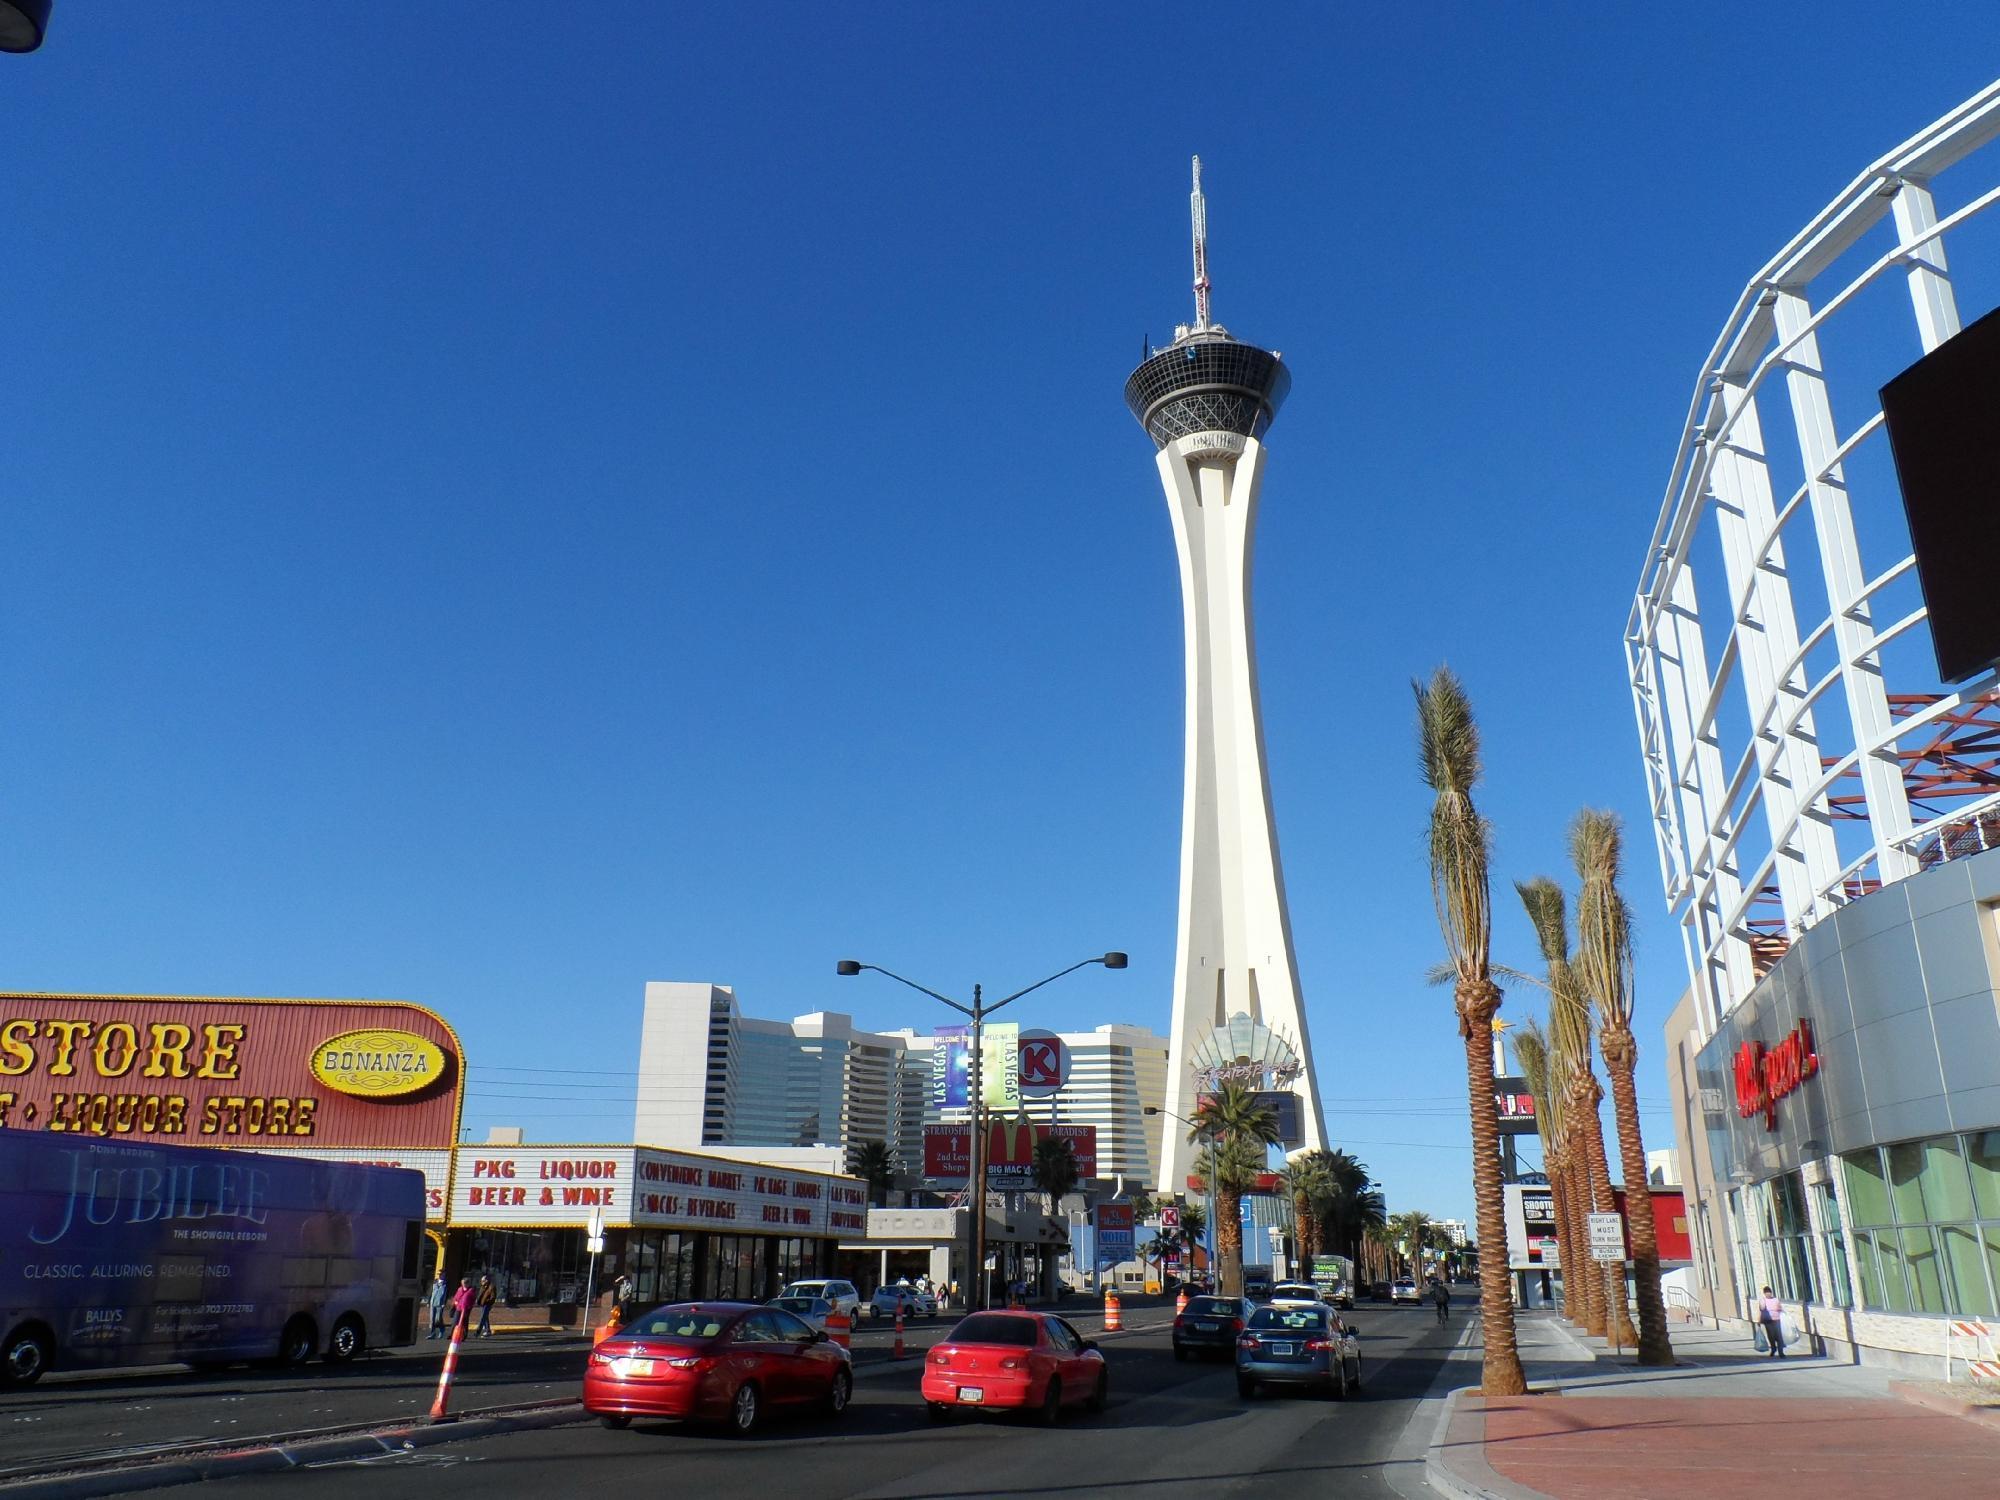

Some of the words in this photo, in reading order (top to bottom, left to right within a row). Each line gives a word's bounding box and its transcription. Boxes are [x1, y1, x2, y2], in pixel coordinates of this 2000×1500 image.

[0, 1018, 246, 1079] STORE
[1005, 1042, 1017, 1061] LAS
[324, 1050, 429, 1073] BONANZA
[933, 1045, 946, 1079] VEGAS
[1023, 1046, 1056, 1078] K
[933, 1083, 946, 1103] LAS
[1005, 1065, 1018, 1101] VEGAS
[47, 1092, 187, 1137] LIQUOR
[200, 1095, 318, 1136] STORE
[1049, 1127, 1089, 1136] PARADISE
[936, 1152, 951, 1161] 2nd
[473, 1160, 516, 1178] PKG
[540, 1160, 616, 1180] LIQUOR
[640, 1161, 703, 1187] CONVENIENCE
[988, 1165, 1002, 1173] BIG
[1004, 1165, 1022, 1173] MAC
[28, 1150, 269, 1245] JUBILEE
[469, 1187, 526, 1206] BEER
[539, 1187, 554, 1206] &
[831, 1186, 842, 1202] LAS
[844, 1189, 865, 1205] VEGAS
[687, 1198, 736, 1219] BEVERAGES
[762, 1205, 781, 1222] BEER
[173, 1229, 188, 1239] THE
[190, 1229, 234, 1241] SHOWGIRL
[1101, 1231, 1128, 1242] MOTEL
